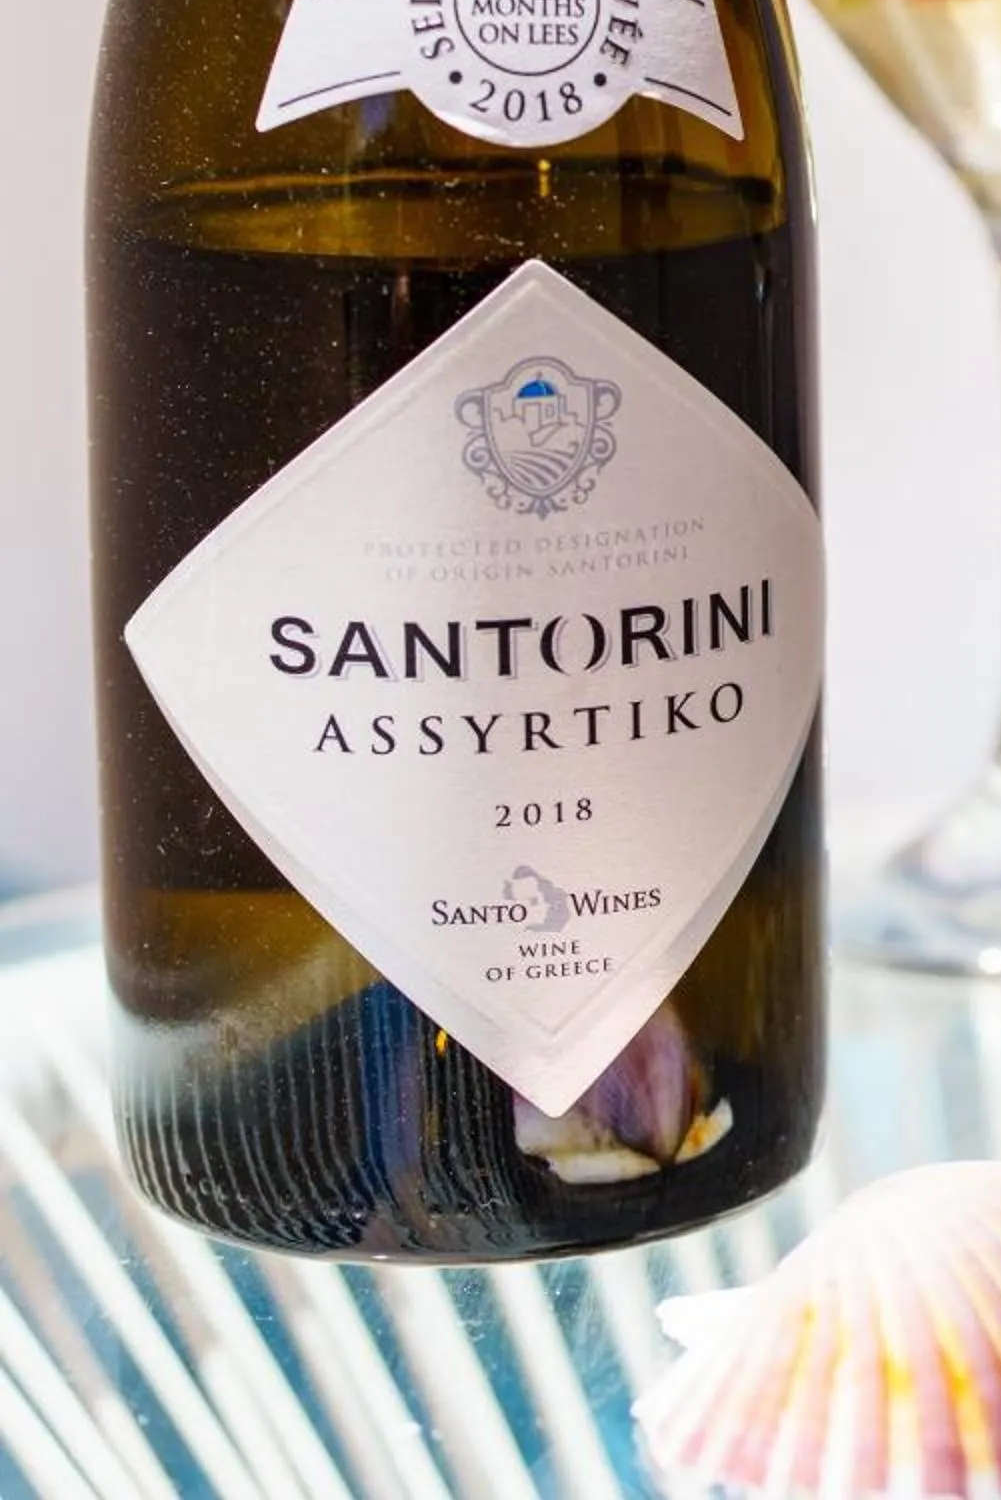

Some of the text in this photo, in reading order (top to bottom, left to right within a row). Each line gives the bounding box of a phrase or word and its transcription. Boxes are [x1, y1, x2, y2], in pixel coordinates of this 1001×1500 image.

[479, 23, 579, 46] ON LEES
[470, 79, 584, 123] 2018
[362, 517, 706, 560] PROTECTED DESIGNATION
[384, 546, 690, 582] OF ORIGIN SANTORINI
[270, 580, 775, 680] SANTORINI
[313, 682, 745, 756] ASSYRTIKO
[495, 798, 593, 827] 2018
[431, 888, 662, 926] SANTO WINES
[518, 940, 581, 958] WINE
[485, 957, 614, 982] OF GREECE
